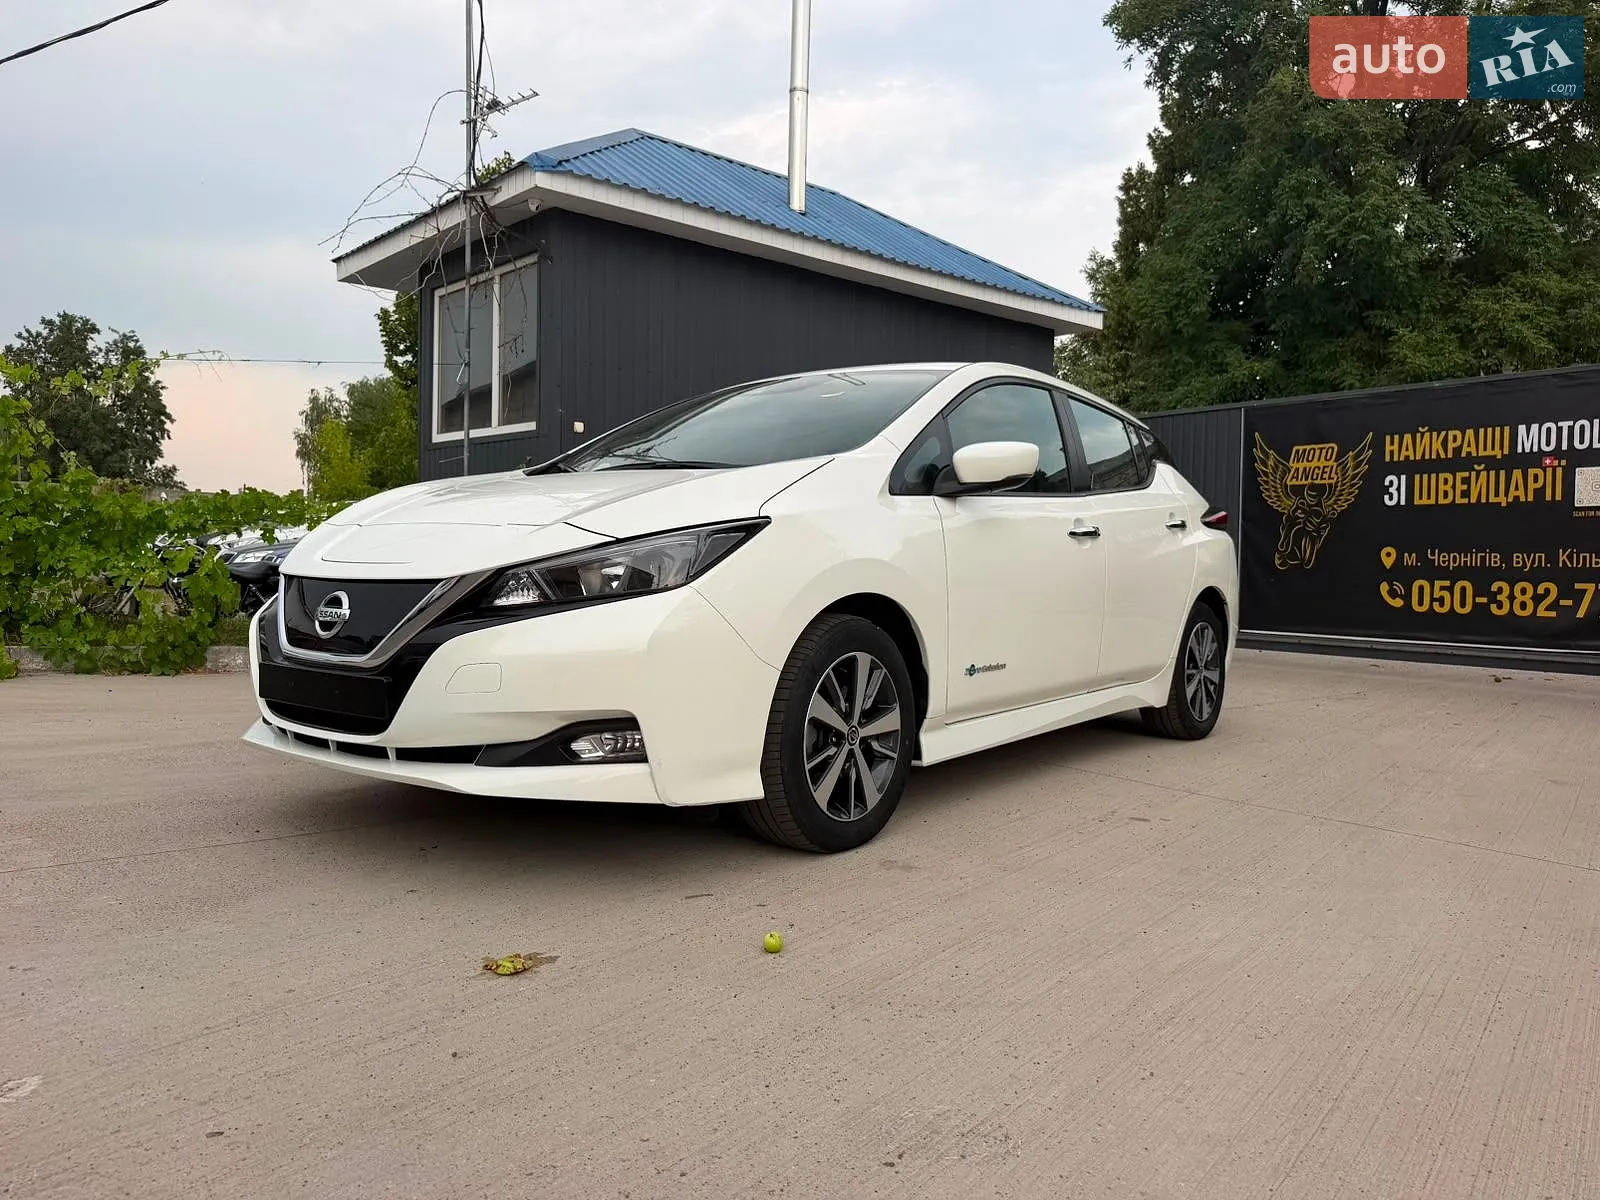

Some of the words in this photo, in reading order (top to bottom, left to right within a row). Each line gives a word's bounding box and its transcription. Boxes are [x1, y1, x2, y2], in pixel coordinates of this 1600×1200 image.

[1291, 446, 1335, 464] MOTO
[1384, 425, 1510, 462] НАЙКРАЩІ
[1289, 465, 1336, 482] ANGEL
[1383, 474, 1406, 506] ЗІ
[1413, 459, 1566, 507] ШВЕЙЦАРІЇ
[1403, 552, 1421, 567] м.
[1427, 548, 1506, 571] Чернігів,
[1512, 552, 1551, 572] вул.
[1411, 580, 1600, 618] 050-382-7
